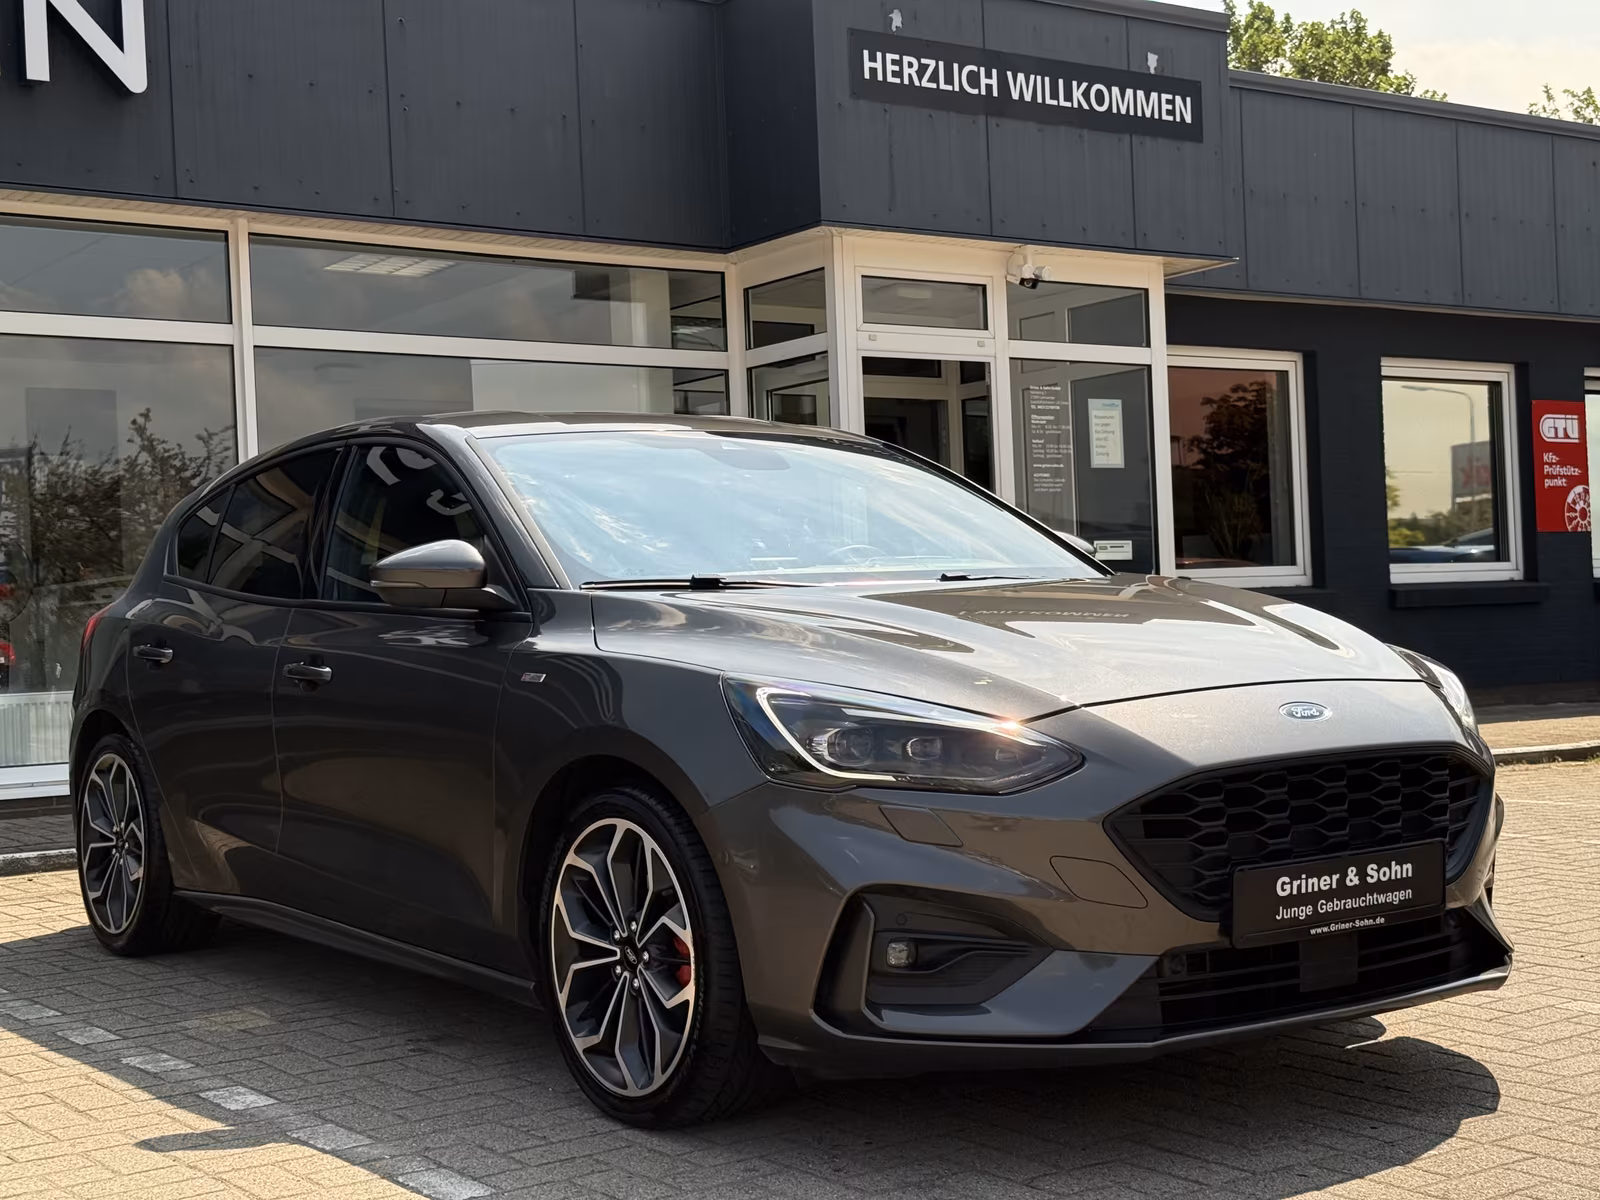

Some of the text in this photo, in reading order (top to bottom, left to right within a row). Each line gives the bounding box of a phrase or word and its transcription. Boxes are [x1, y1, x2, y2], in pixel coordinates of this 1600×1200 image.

[862, 49, 1193, 124] HERZLICH WILLKOMMEN
[1543, 452, 1559, 462] Kfz-
[1543, 465, 1582, 475] Prüfstütz-
[1544, 475, 1567, 488] punkt
[1276, 861, 1413, 897] Griner & Sohn
[1275, 888, 1413, 920] Junge Gebrauchtwagen
[1310, 916, 1385, 935] www.Griner-Sohn.de
